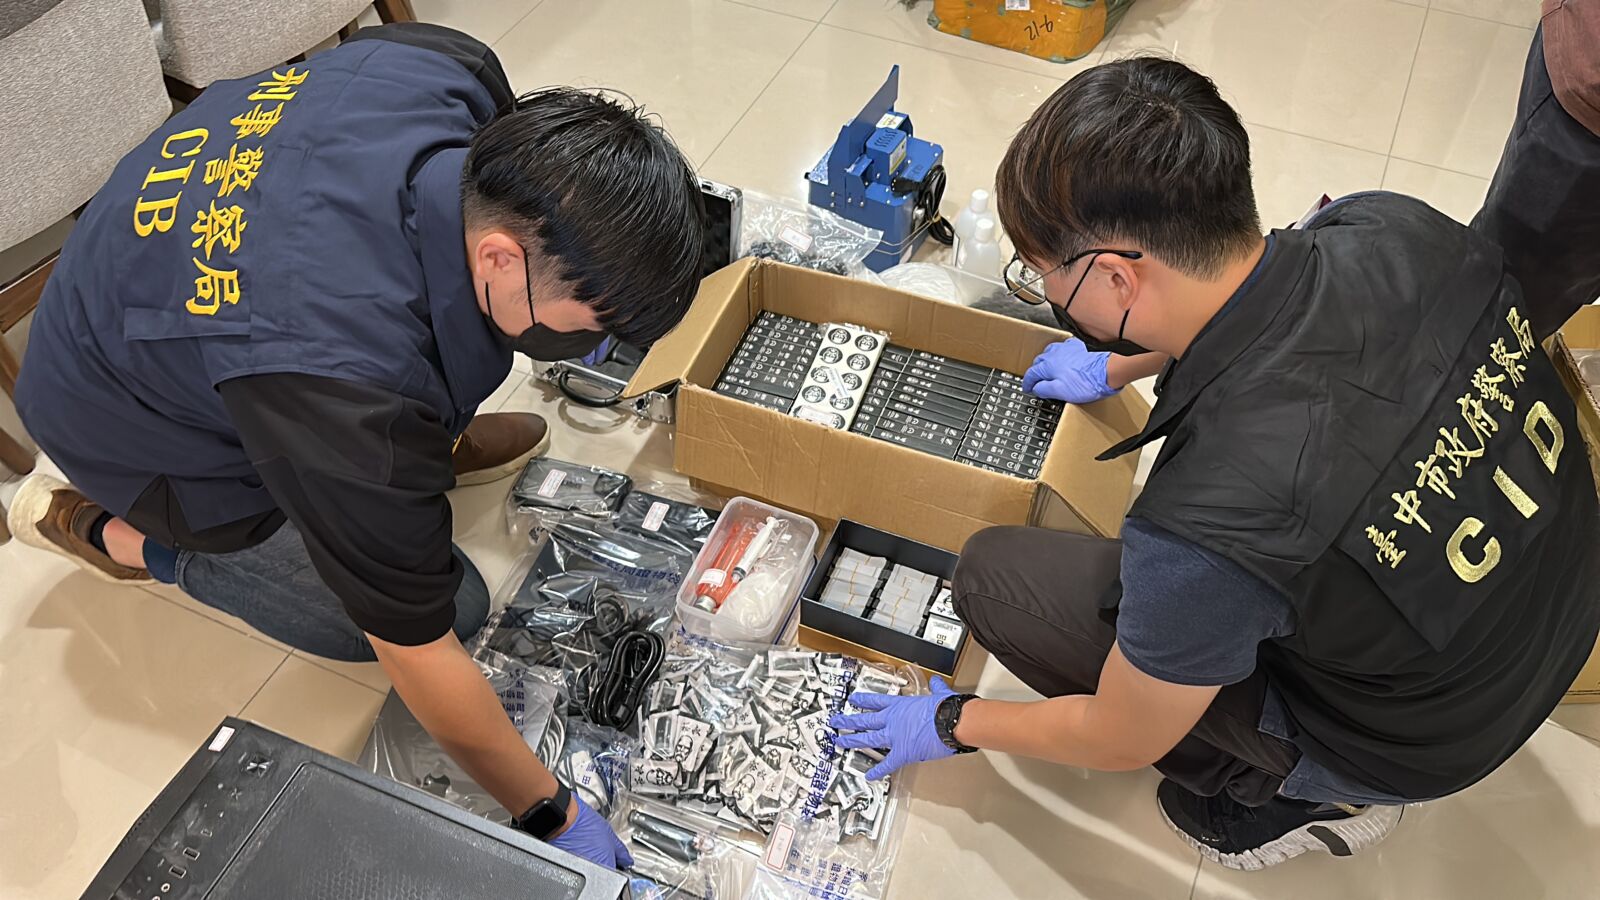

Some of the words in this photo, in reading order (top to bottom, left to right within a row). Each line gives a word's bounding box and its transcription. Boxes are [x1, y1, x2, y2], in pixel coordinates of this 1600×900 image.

[1023, 14, 1054, 41] 9-12
[132, 126, 210, 239] CIB
[185, 66, 310, 316] 刑事警察局
[1365, 305, 1536, 569] 臺中市政府警察局
[1446, 399, 1565, 584] CID
